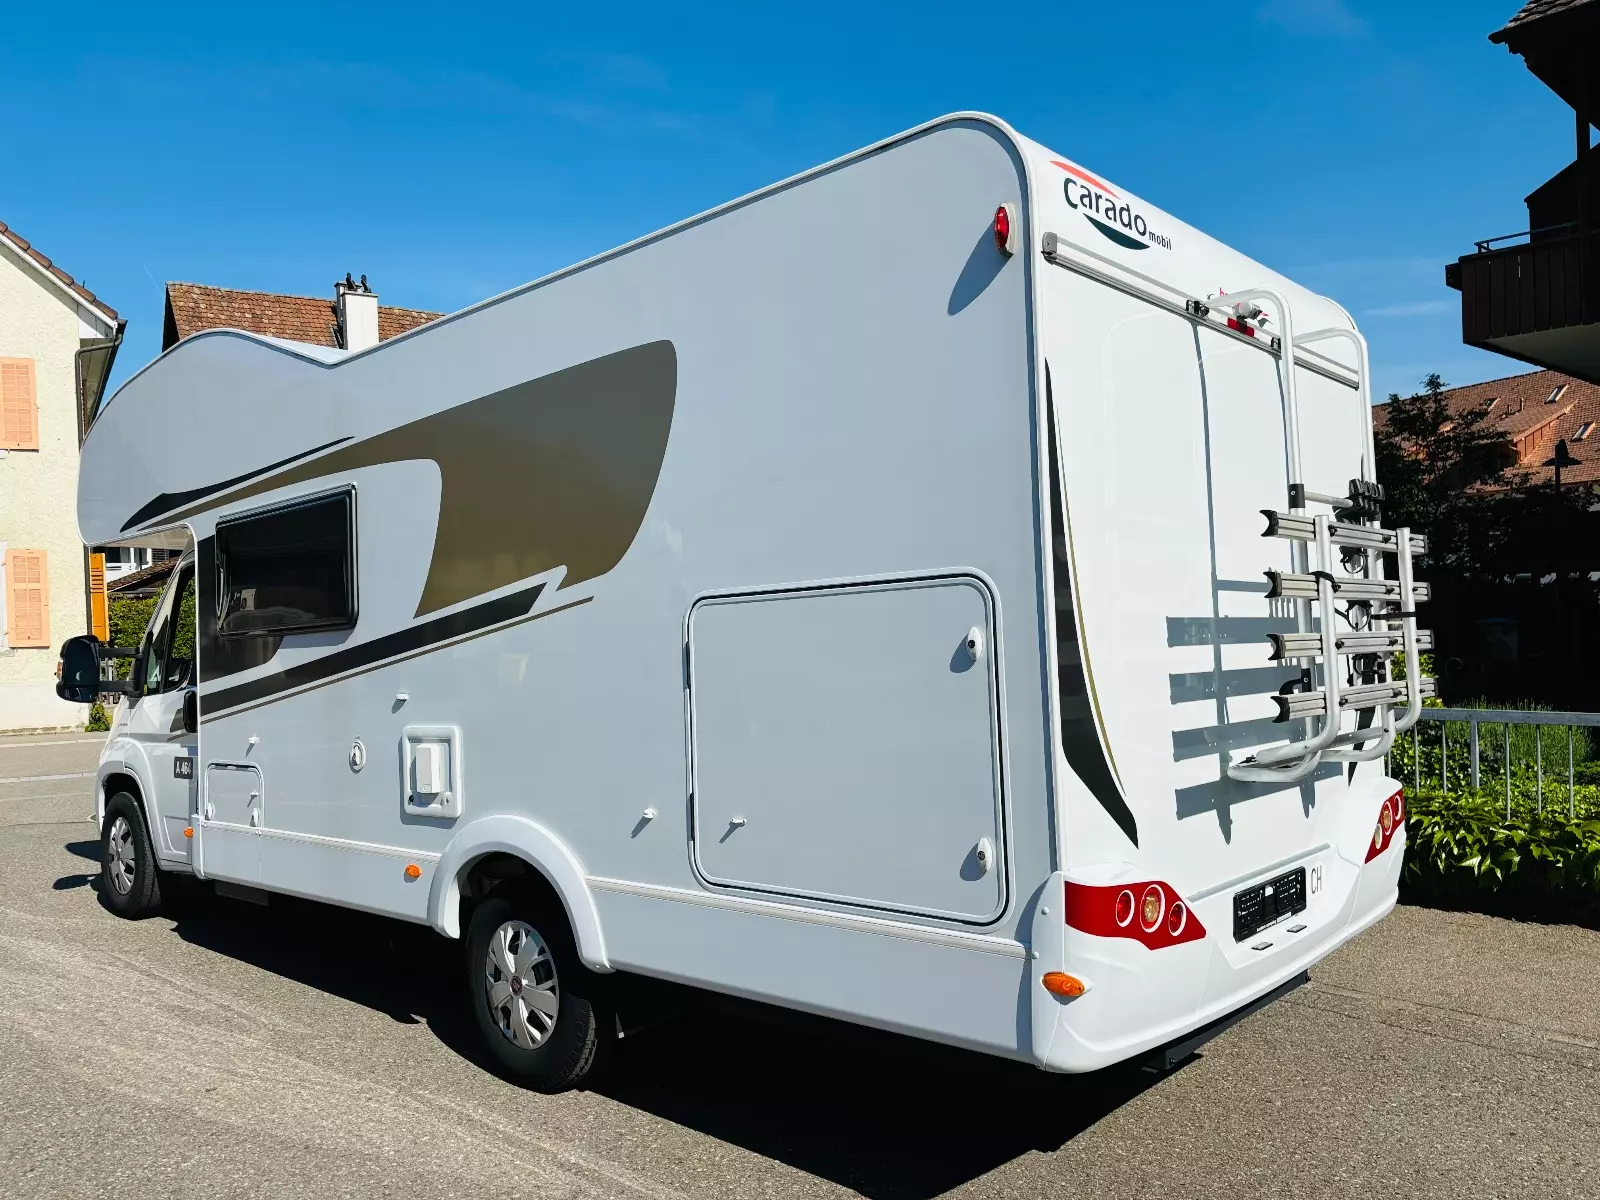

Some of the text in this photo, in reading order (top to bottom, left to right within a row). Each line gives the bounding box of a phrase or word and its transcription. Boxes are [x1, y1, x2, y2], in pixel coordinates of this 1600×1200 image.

[1063, 177, 1172, 251] Carado mobil
[175, 760, 181, 774] A
[1311, 864, 1323, 894] CH
